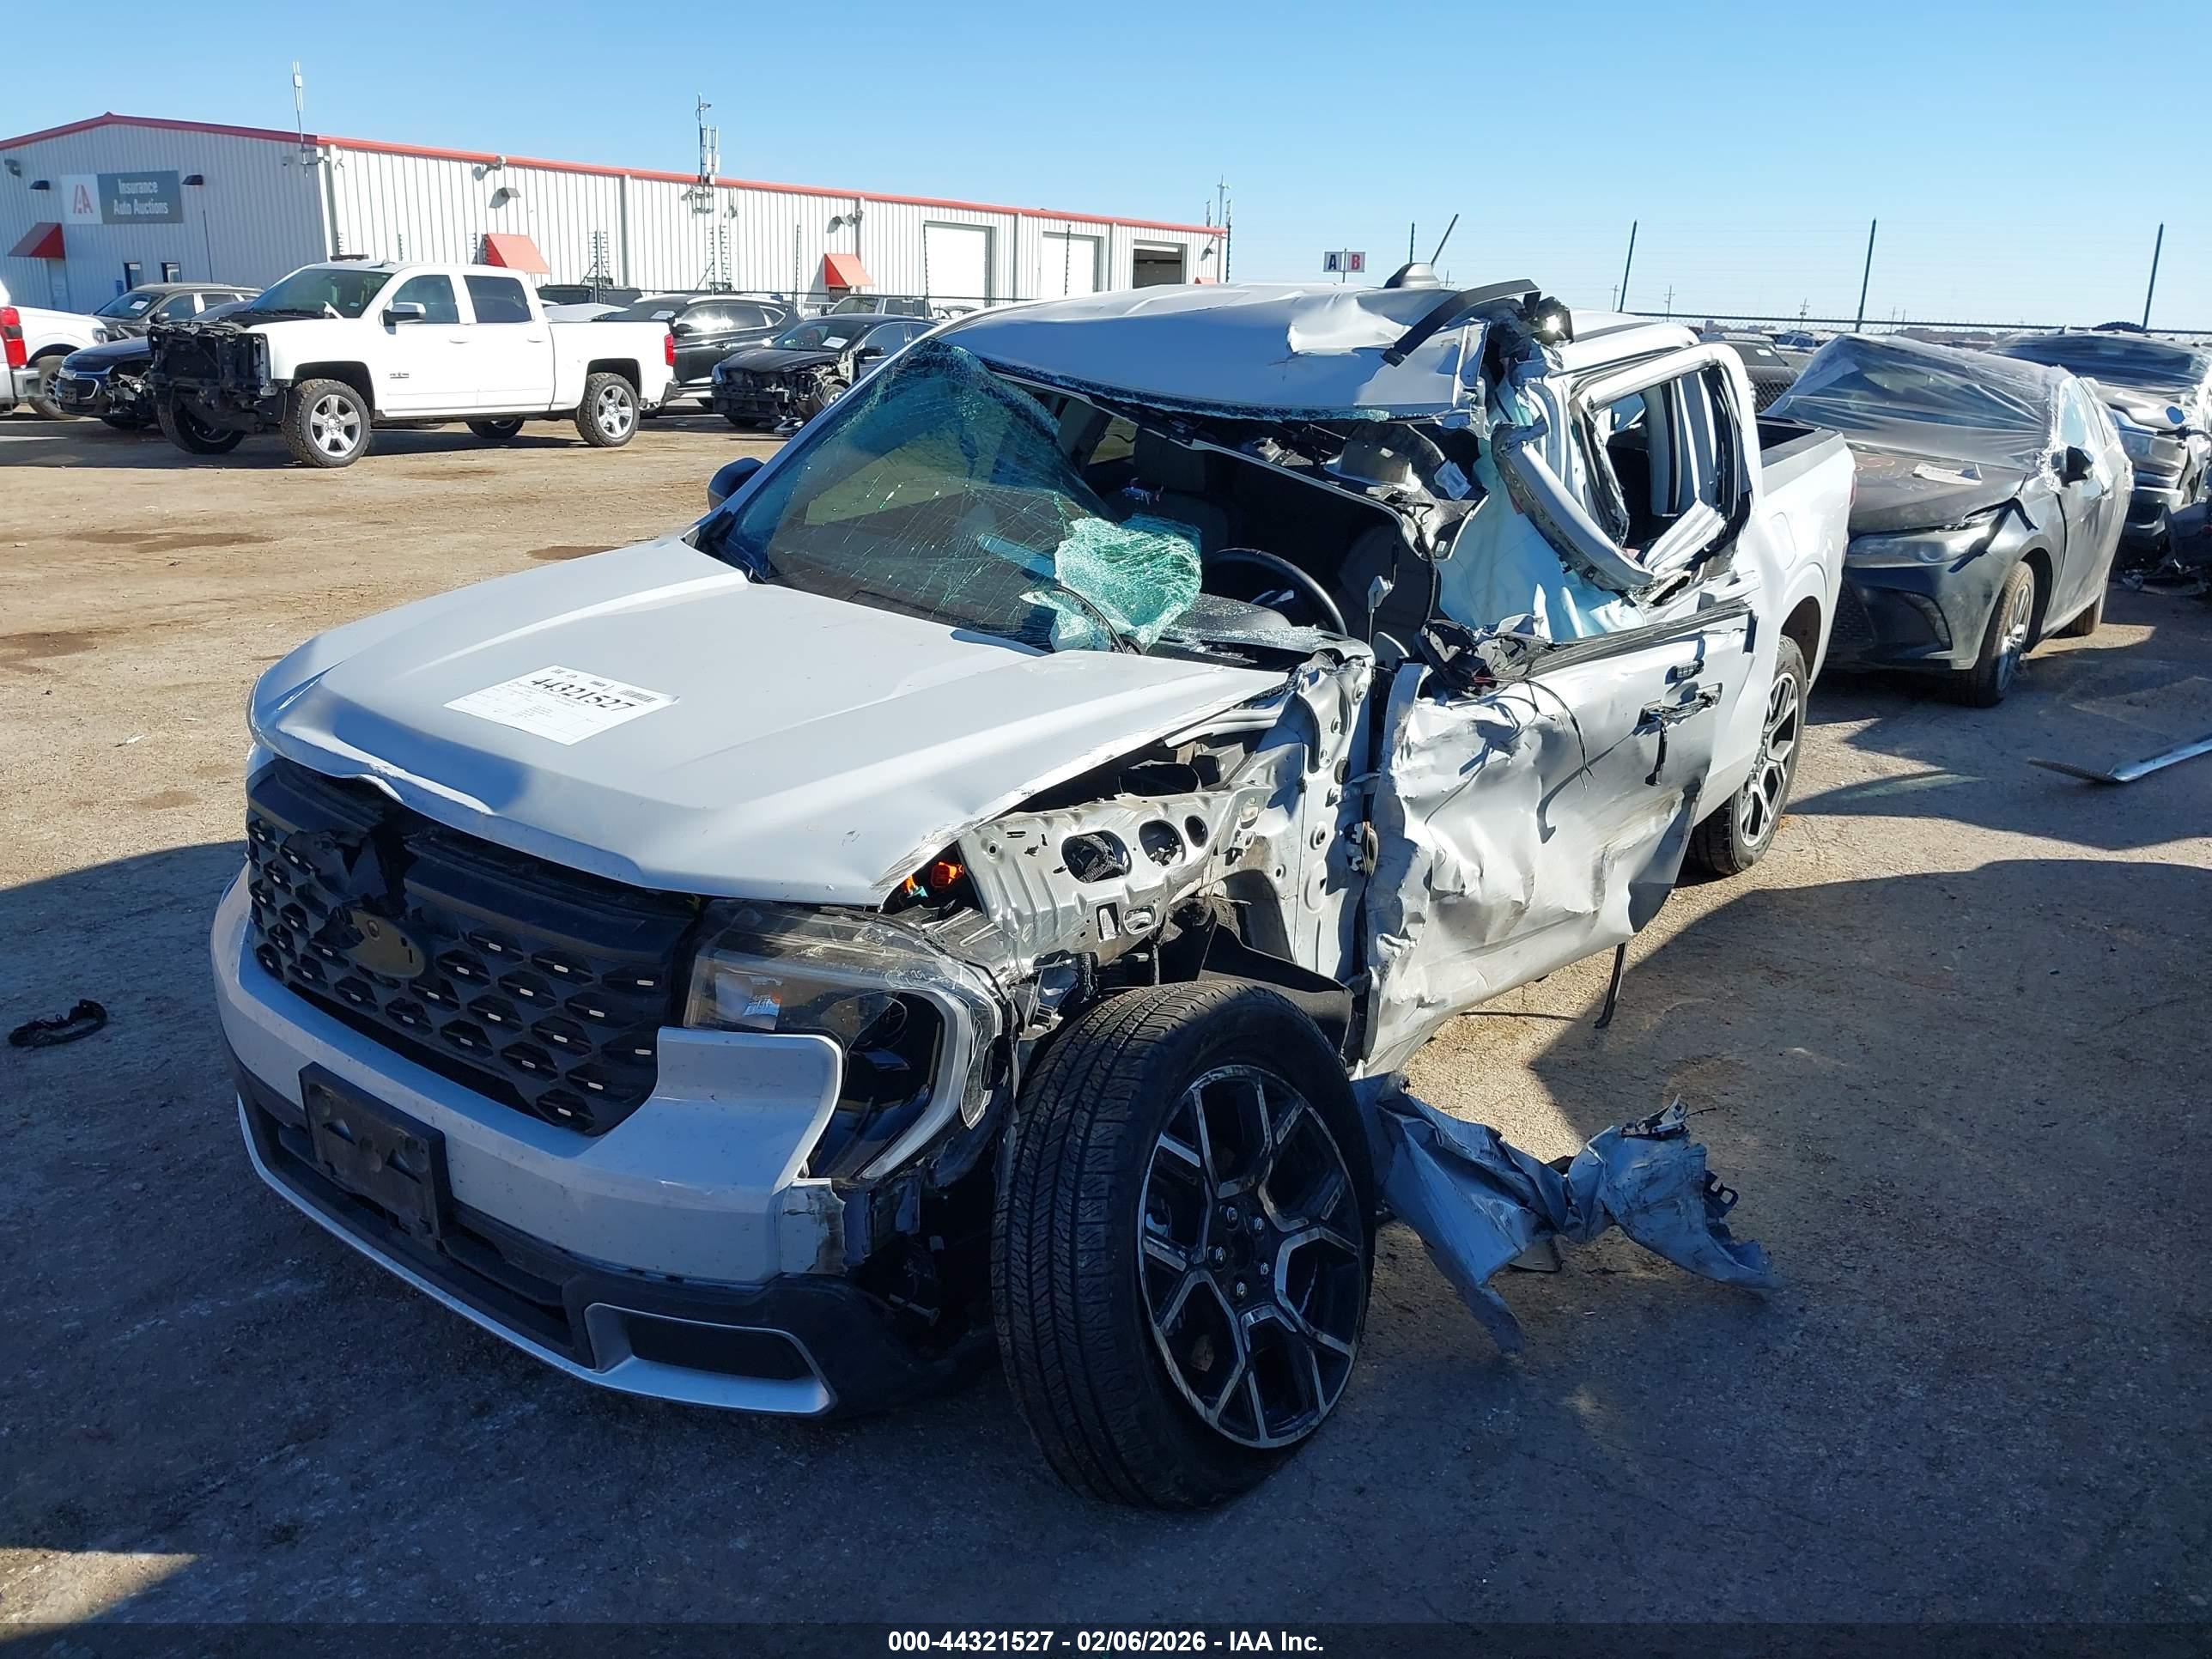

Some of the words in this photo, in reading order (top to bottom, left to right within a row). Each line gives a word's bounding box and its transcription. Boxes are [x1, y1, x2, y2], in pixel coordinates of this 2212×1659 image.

[118, 178, 158, 194] Insurance
[113, 198, 132, 215] Auto
[133, 198, 169, 214] Auctions
[1328, 254, 1337, 270] A
[1351, 254, 1361, 270] B
[531, 678, 636, 711] 44321527
